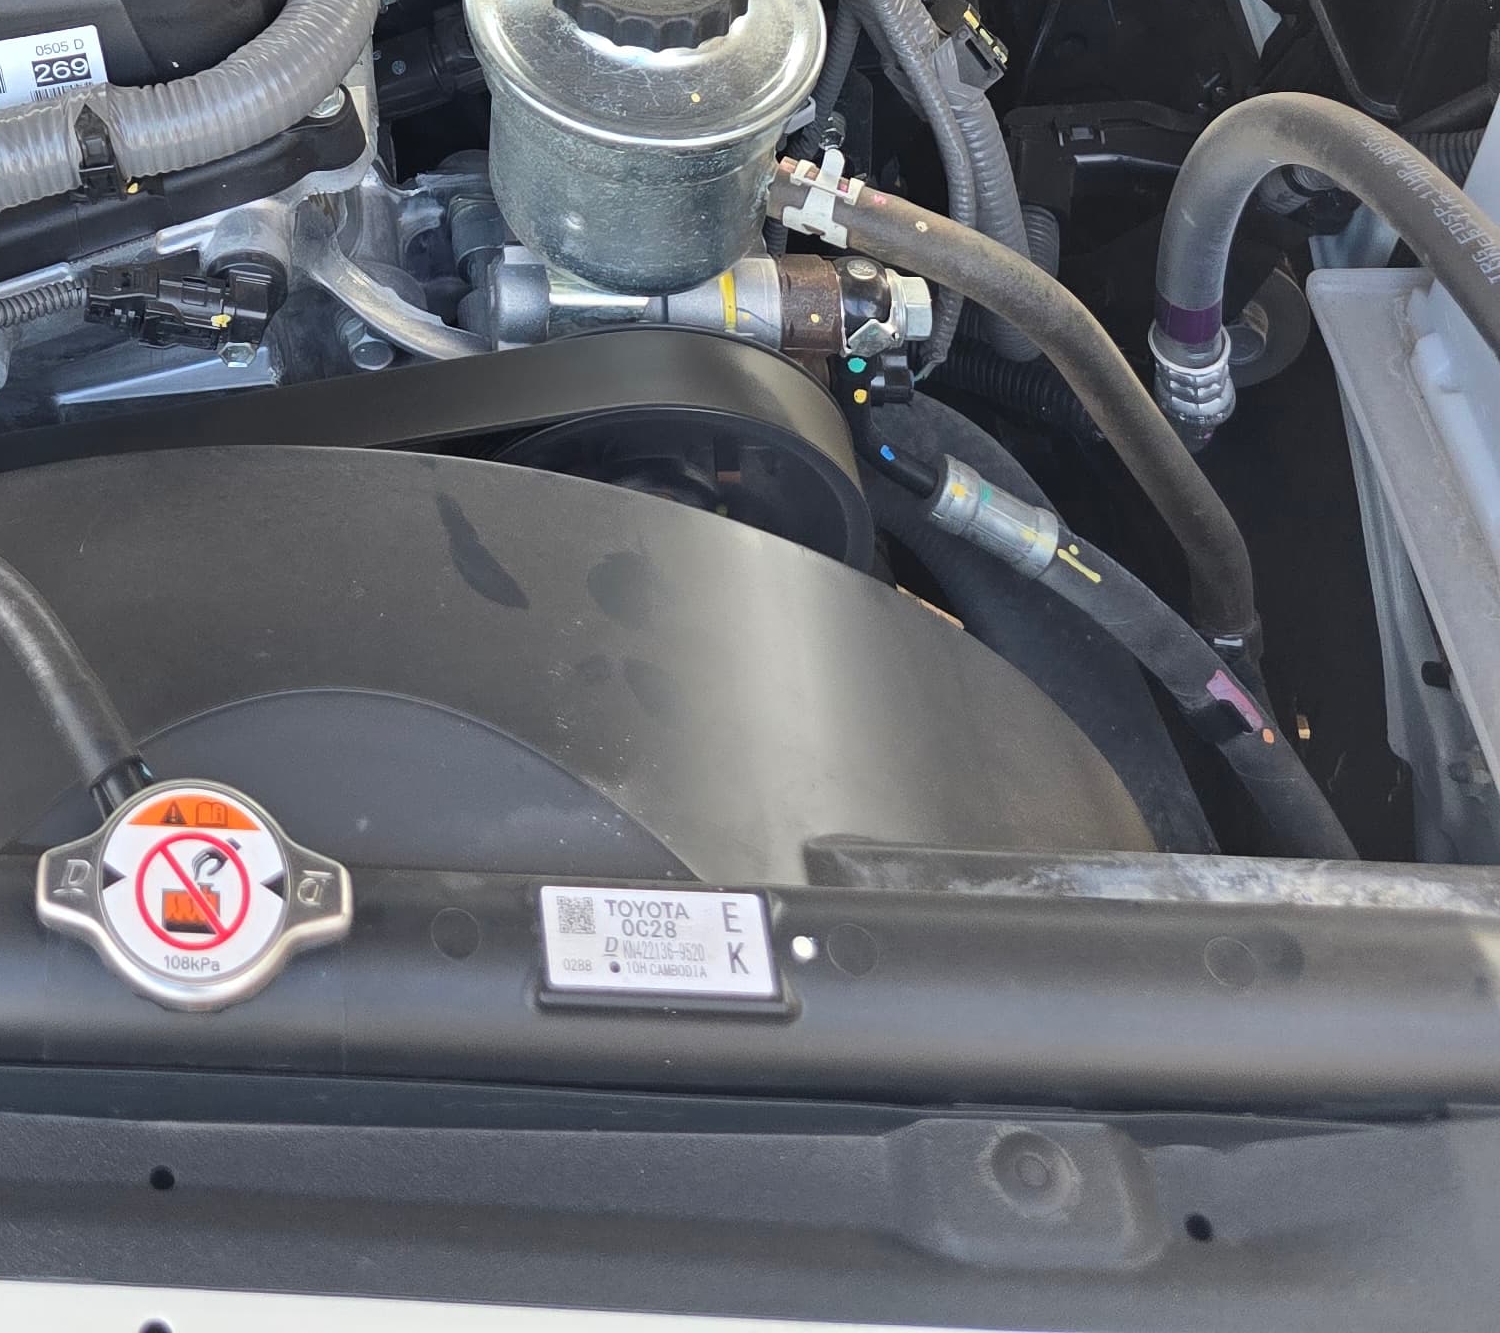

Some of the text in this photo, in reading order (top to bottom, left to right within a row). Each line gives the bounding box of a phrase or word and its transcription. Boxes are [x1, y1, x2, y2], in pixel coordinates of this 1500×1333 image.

[35, 38, 85, 57] 0505 D
[35, 57, 90, 84] 269
[604, 898, 690, 920] TOYOTA
[722, 901, 742, 933] E
[163, 954, 221, 973] 108kPa
[728, 942, 749, 975] K
[650, 962, 707, 979] CAMBODIA
